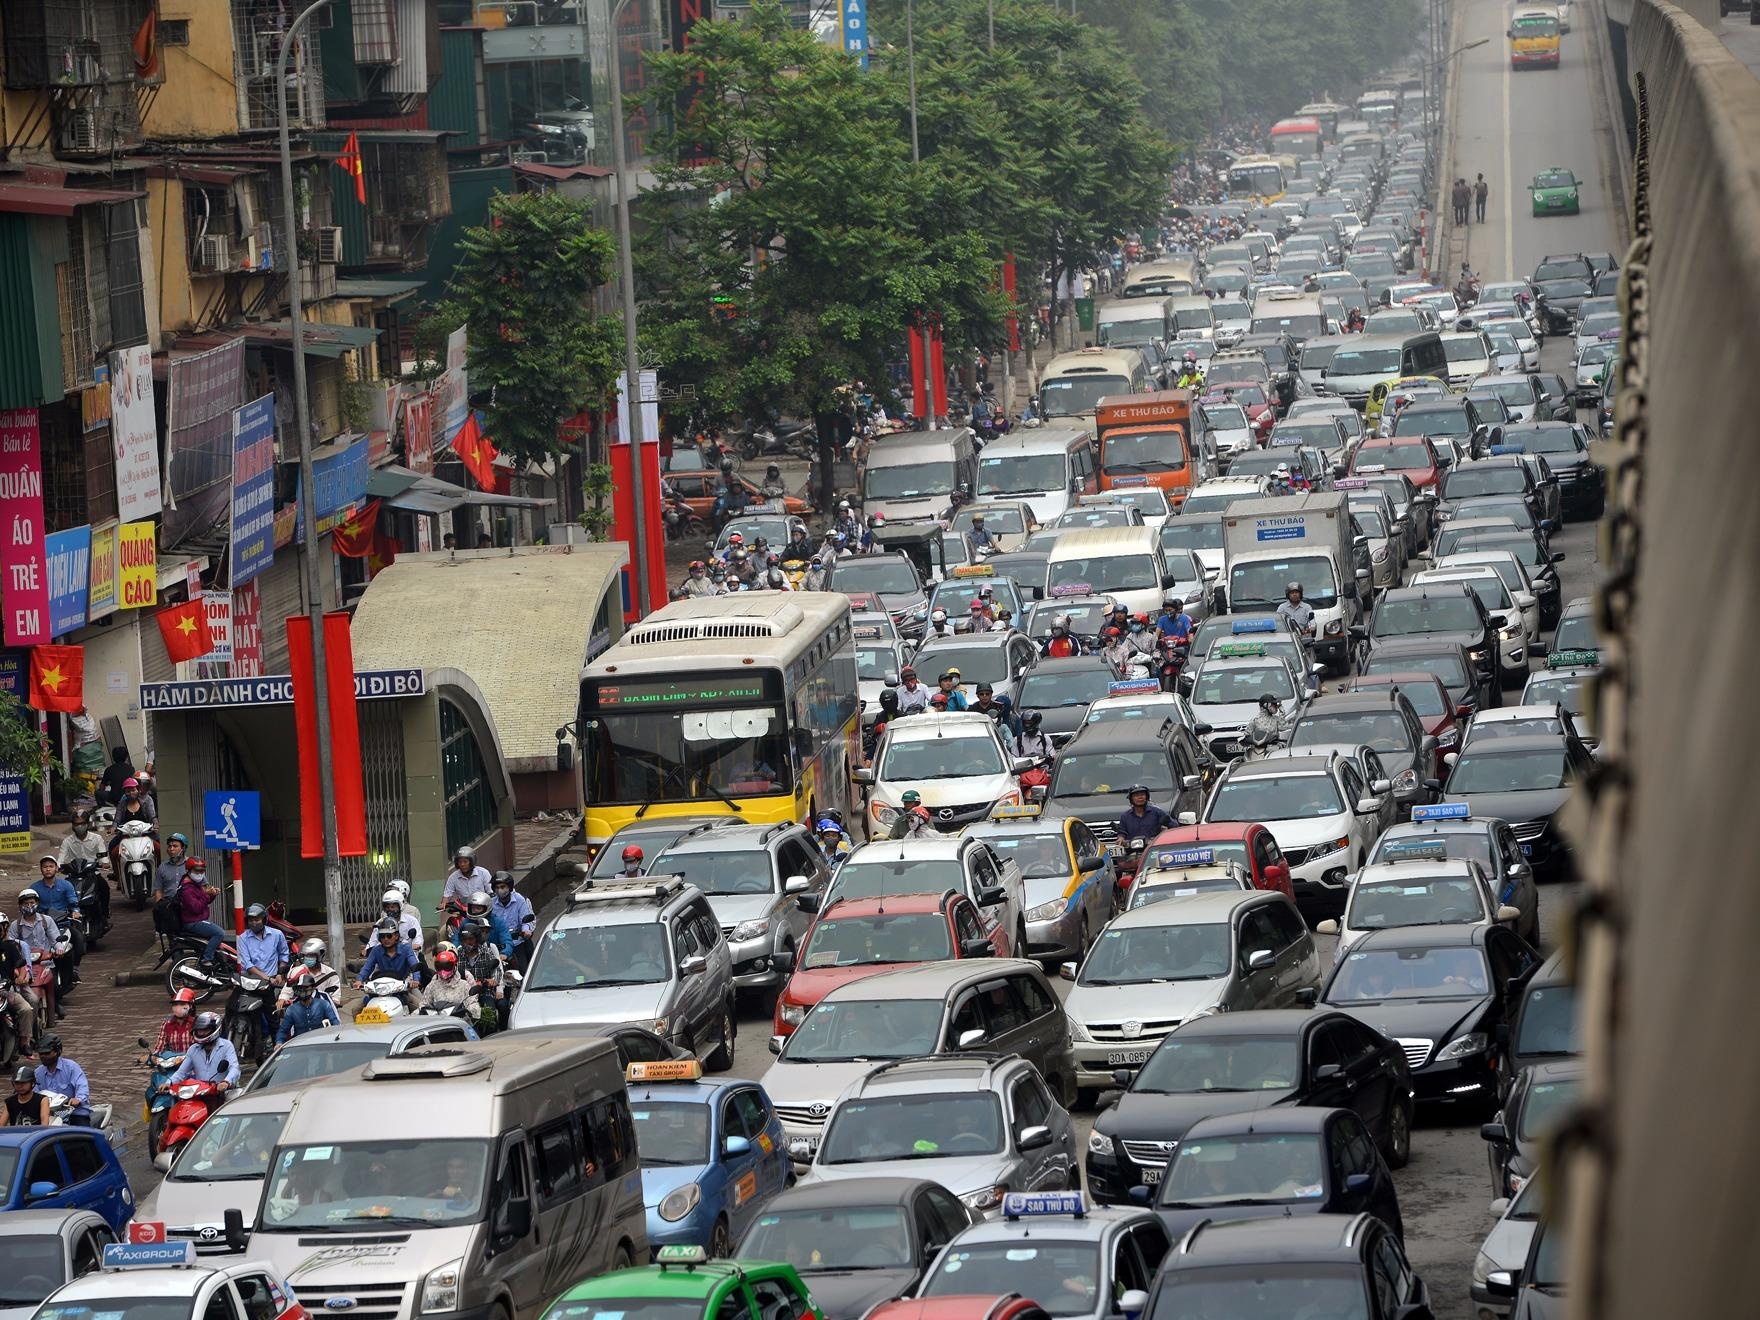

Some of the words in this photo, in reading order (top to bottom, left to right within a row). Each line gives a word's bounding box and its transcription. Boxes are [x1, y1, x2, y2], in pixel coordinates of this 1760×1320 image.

[0, 410, 12, 429] án
[15, 410, 37, 428] buôn
[1113, 408, 1127, 418] XE
[3, 433, 20, 453] Bán
[0, 463, 41, 500] QUẦN
[12, 514, 33, 546] ÁO
[1256, 519, 1268, 527] XE
[1269, 517, 1287, 527] THƯ
[120, 527, 154, 571] QUẢNG
[10, 556, 40, 591] TRẺ
[124, 574, 152, 605] CÁO
[16, 608, 40, 636] EM
[142, 683, 192, 707] HẦM
[194, 682, 252, 705] DÀNH
[369, 675, 391, 695] ĐI
[394, 670, 421, 695] BỘ
[1428, 808, 1441, 816] TAXI
[1441, 807, 1453, 816] SAO
[1174, 852, 1186, 863] TAXI
[1187, 851, 1198, 862] SAO
[1199, 850, 1211, 863] VIỆT
[1144, 1170, 1161, 1184] 29A
[1028, 1200, 1044, 1212] SAO
[1063, 1198, 1075, 1211] ĐÔ
[117, 1249, 184, 1261] TAXIGROUP
[663, 1245, 697, 1257] TAXI
